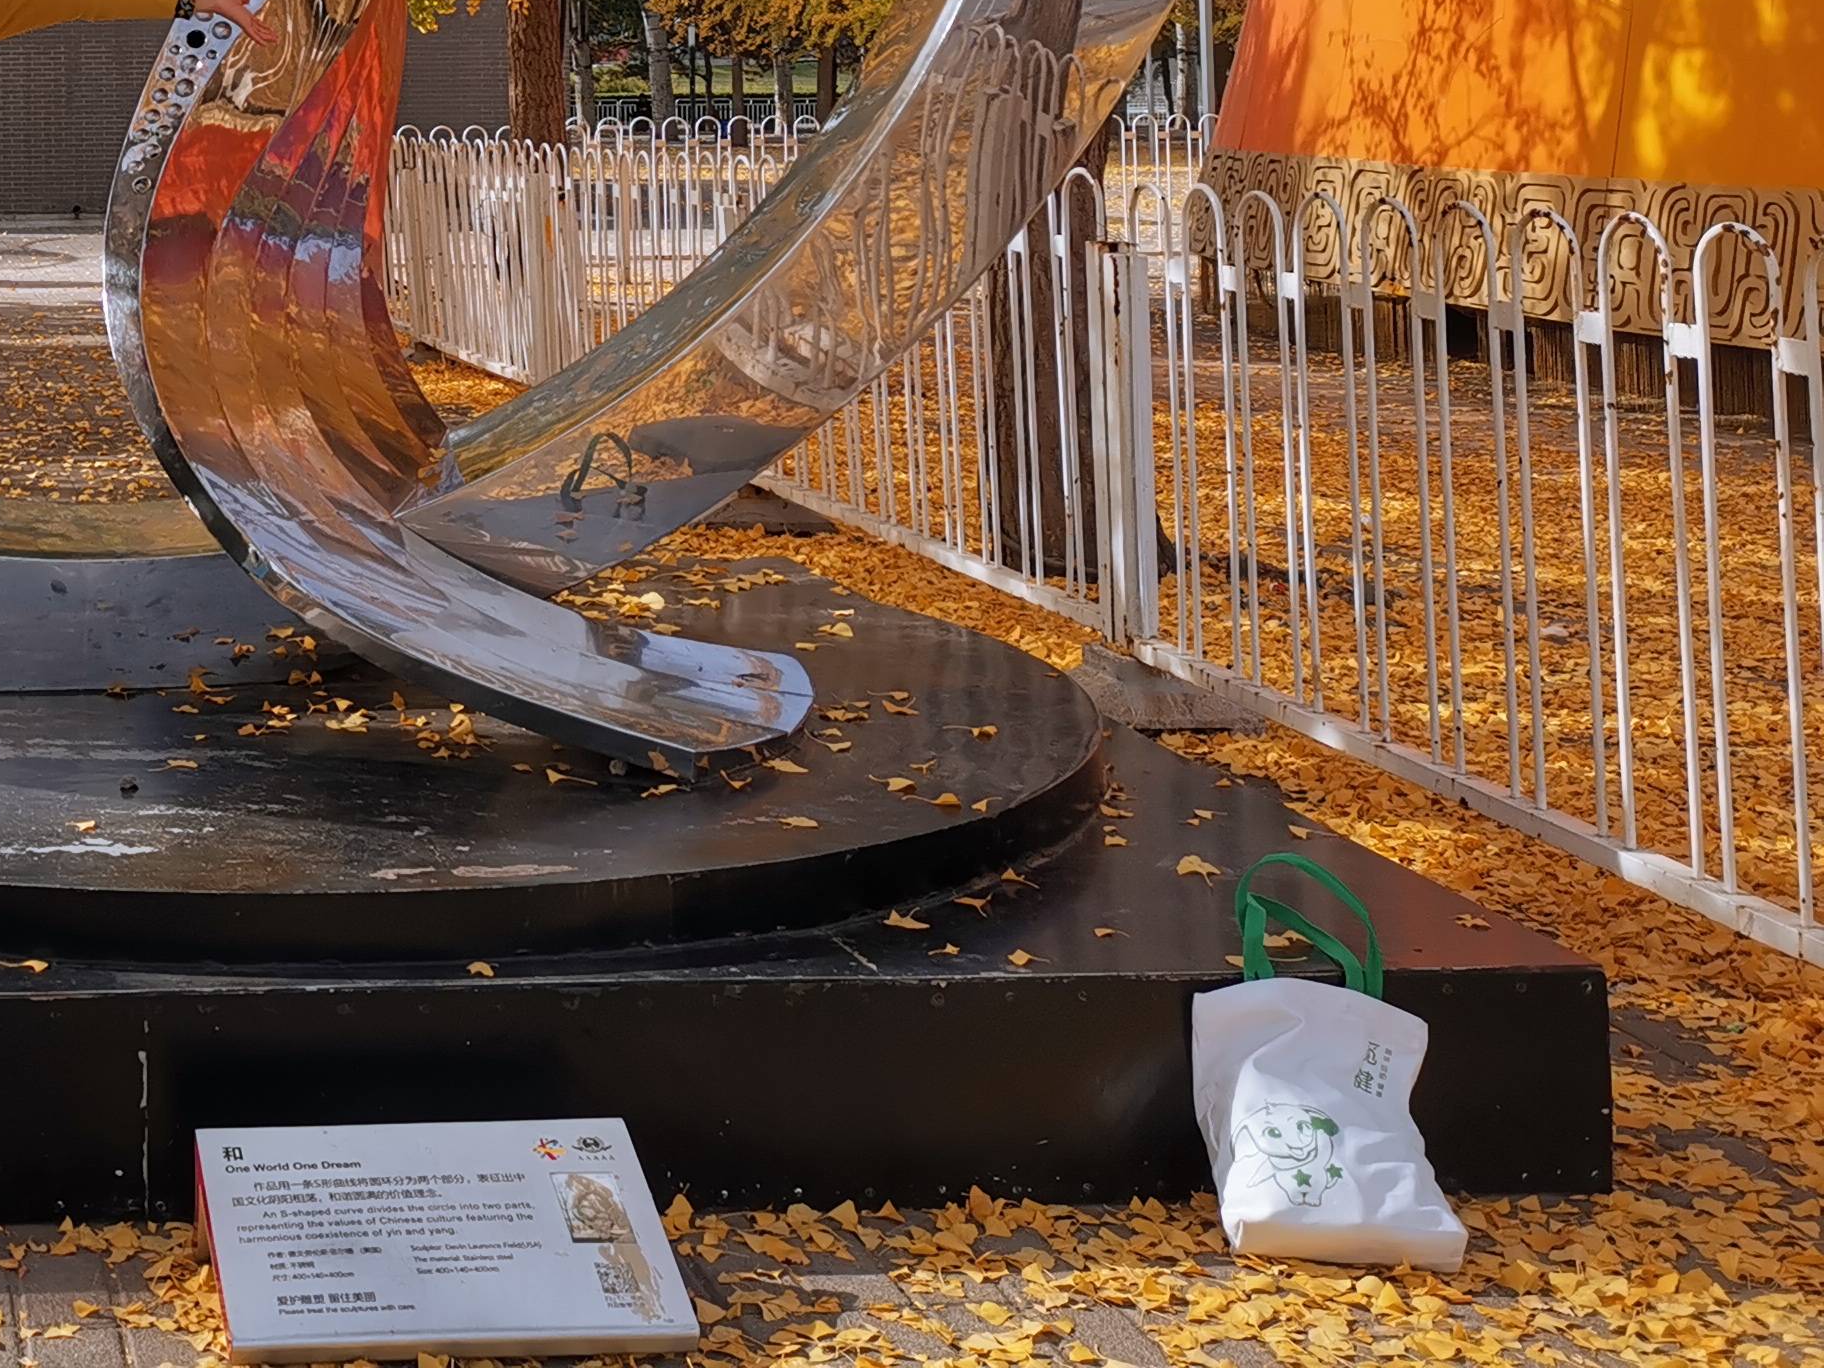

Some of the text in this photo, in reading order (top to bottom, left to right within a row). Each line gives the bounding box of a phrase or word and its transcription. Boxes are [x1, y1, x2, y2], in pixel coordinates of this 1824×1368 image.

[222, 1146, 243, 1161] 和
[226, 1160, 361, 1173] One World One Dream
[263, 1200, 535, 1219] An S-shaped curve divides the circle into two parts,
[237, 1211, 534, 1233] representing the values of Chinese culture featuring the
[239, 1227, 457, 1244] harmonious coexistence of yin and yang.
[414, 1254, 428, 1263] The
[462, 1252, 495, 1262] Stainless
[497, 1251, 514, 1260] steel
[278, 1307, 305, 1316] Please
[307, 1306, 323, 1314] treat
[325, 1305, 338, 1314] the
[340, 1303, 378, 1314] sculptures
[380, 1302, 396, 1312] with
